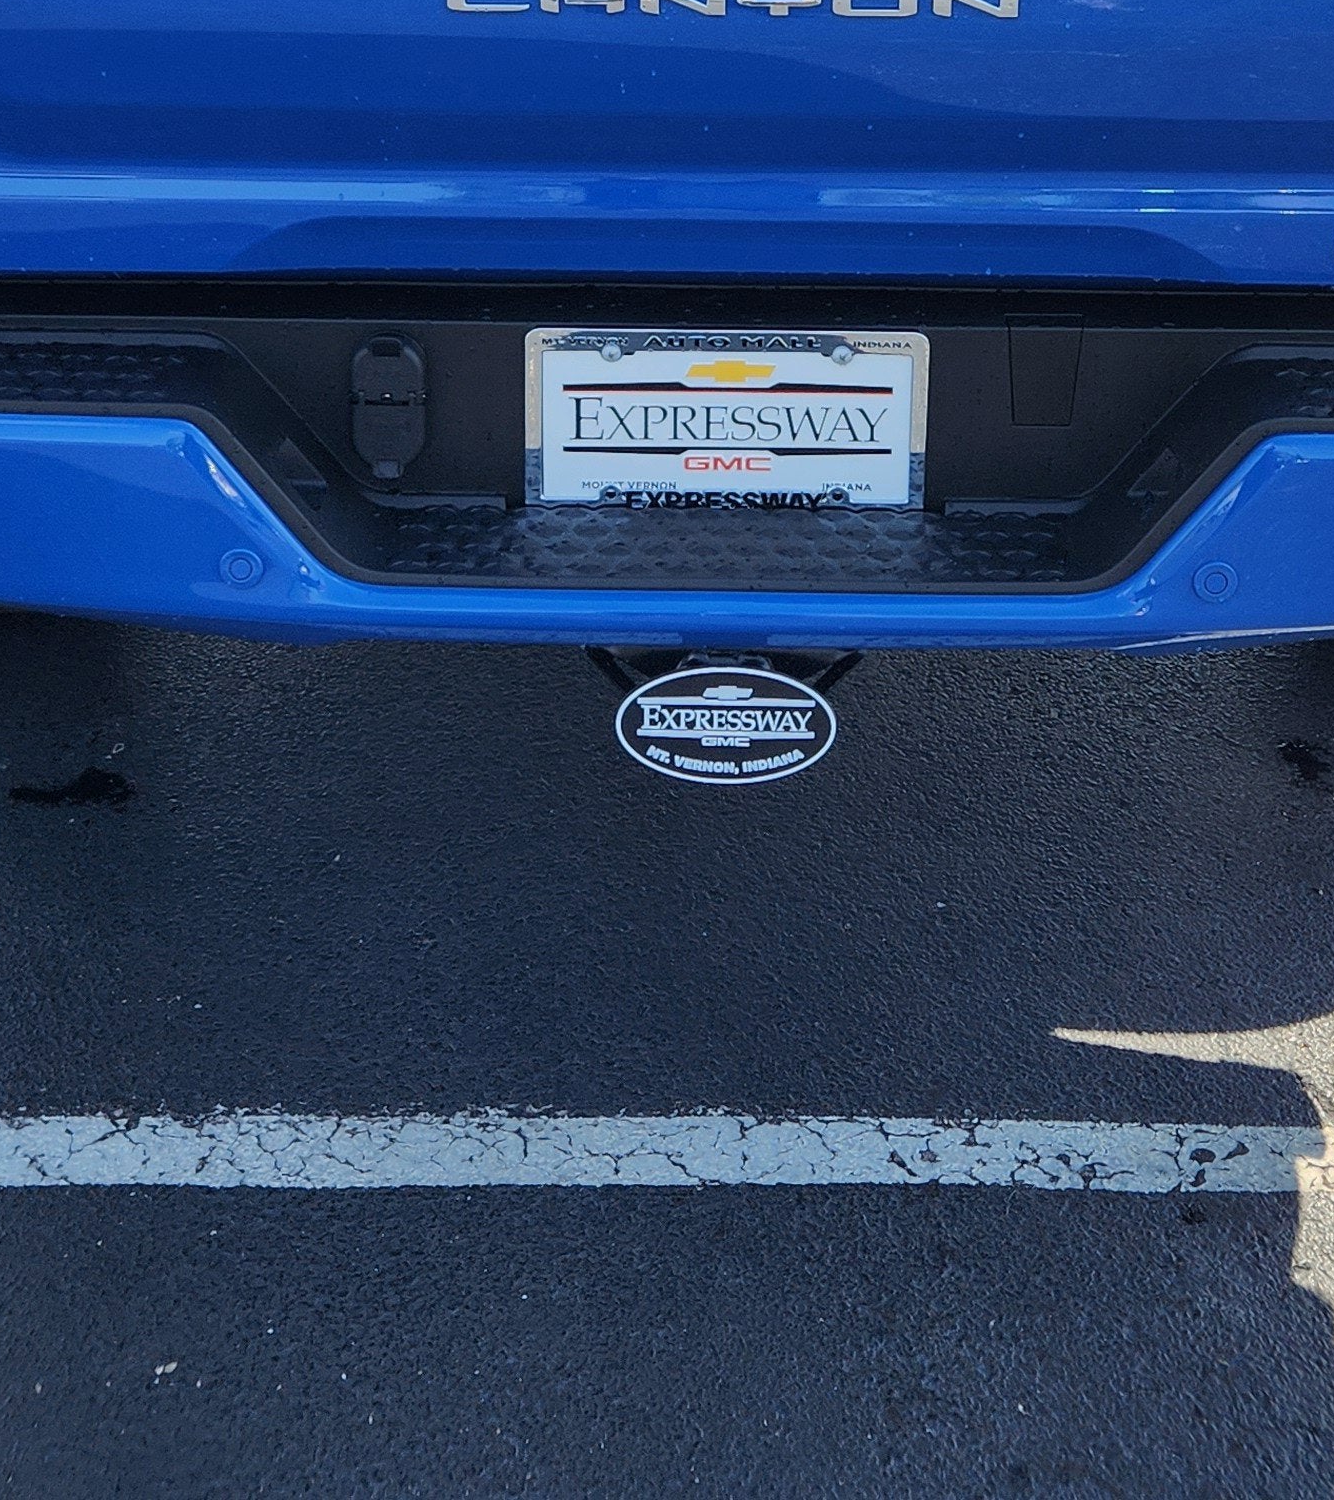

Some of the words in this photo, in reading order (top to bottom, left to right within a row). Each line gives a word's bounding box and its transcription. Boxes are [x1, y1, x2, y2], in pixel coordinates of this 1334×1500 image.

[643, 335, 731, 348] AUTO
[740, 336, 822, 349] MALL
[853, 340, 913, 349] INDIANA
[568, 396, 888, 443] EXPRESSWAY
[683, 456, 772, 471] GMC
[582, 481, 624, 489] MOT
[627, 481, 677, 490] VERNON
[626, 490, 825, 509] EXPRESSWAY
[701, 736, 750, 747] GMC
[646, 745, 671, 764] MT.
[673, 755, 740, 775] VERNON,
[742, 749, 805, 773] INDIANA
